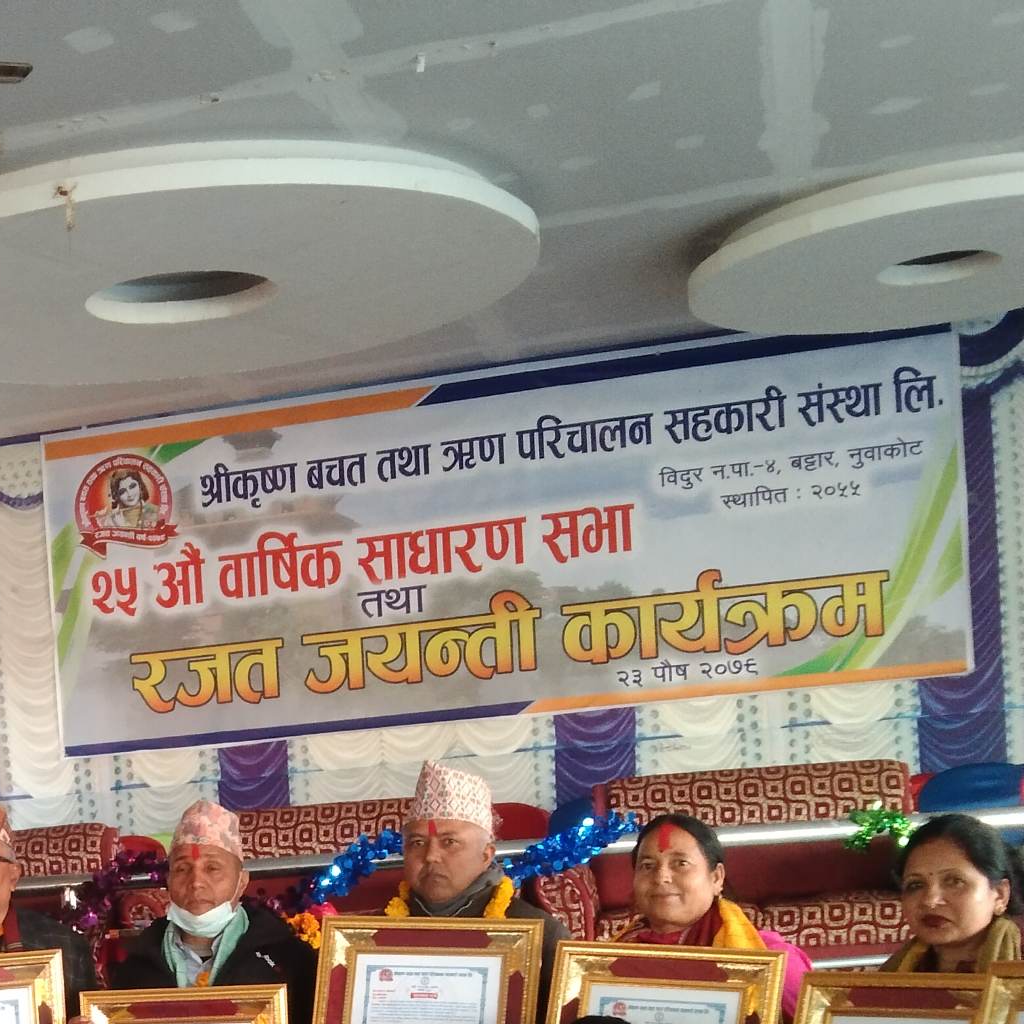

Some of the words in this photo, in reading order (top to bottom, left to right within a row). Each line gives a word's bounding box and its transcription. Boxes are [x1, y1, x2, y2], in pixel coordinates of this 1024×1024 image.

[200, 462, 297, 508] श्रीकृष्ण
[306, 453, 367, 490] बचत
[376, 443, 431, 482] तथा
[440, 432, 506, 472] ऋण
[516, 414, 654, 460] परिचालन
[664, 385, 787, 444] सहकारी
[797, 382, 882, 427] संस्था
[893, 366, 943, 413] लि.
[659, 466, 704, 489] विदुर
[847, 437, 924, 469] नुवाकोट
[720, 485, 788, 509] स्थापित
[91, 567, 138, 616] २५
[218, 531, 343, 599] वार्षिक
[357, 517, 526, 584] साधारण
[541, 503, 634, 563] सभा
[357, 584, 427, 618] तथा
[130, 637, 284, 713] रजत
[301, 590, 541, 694] जयन्ती
[560, 569, 890, 665] कार्यक्रम
[617, 669, 643, 687] २३
[651, 659, 690, 682] पौष
